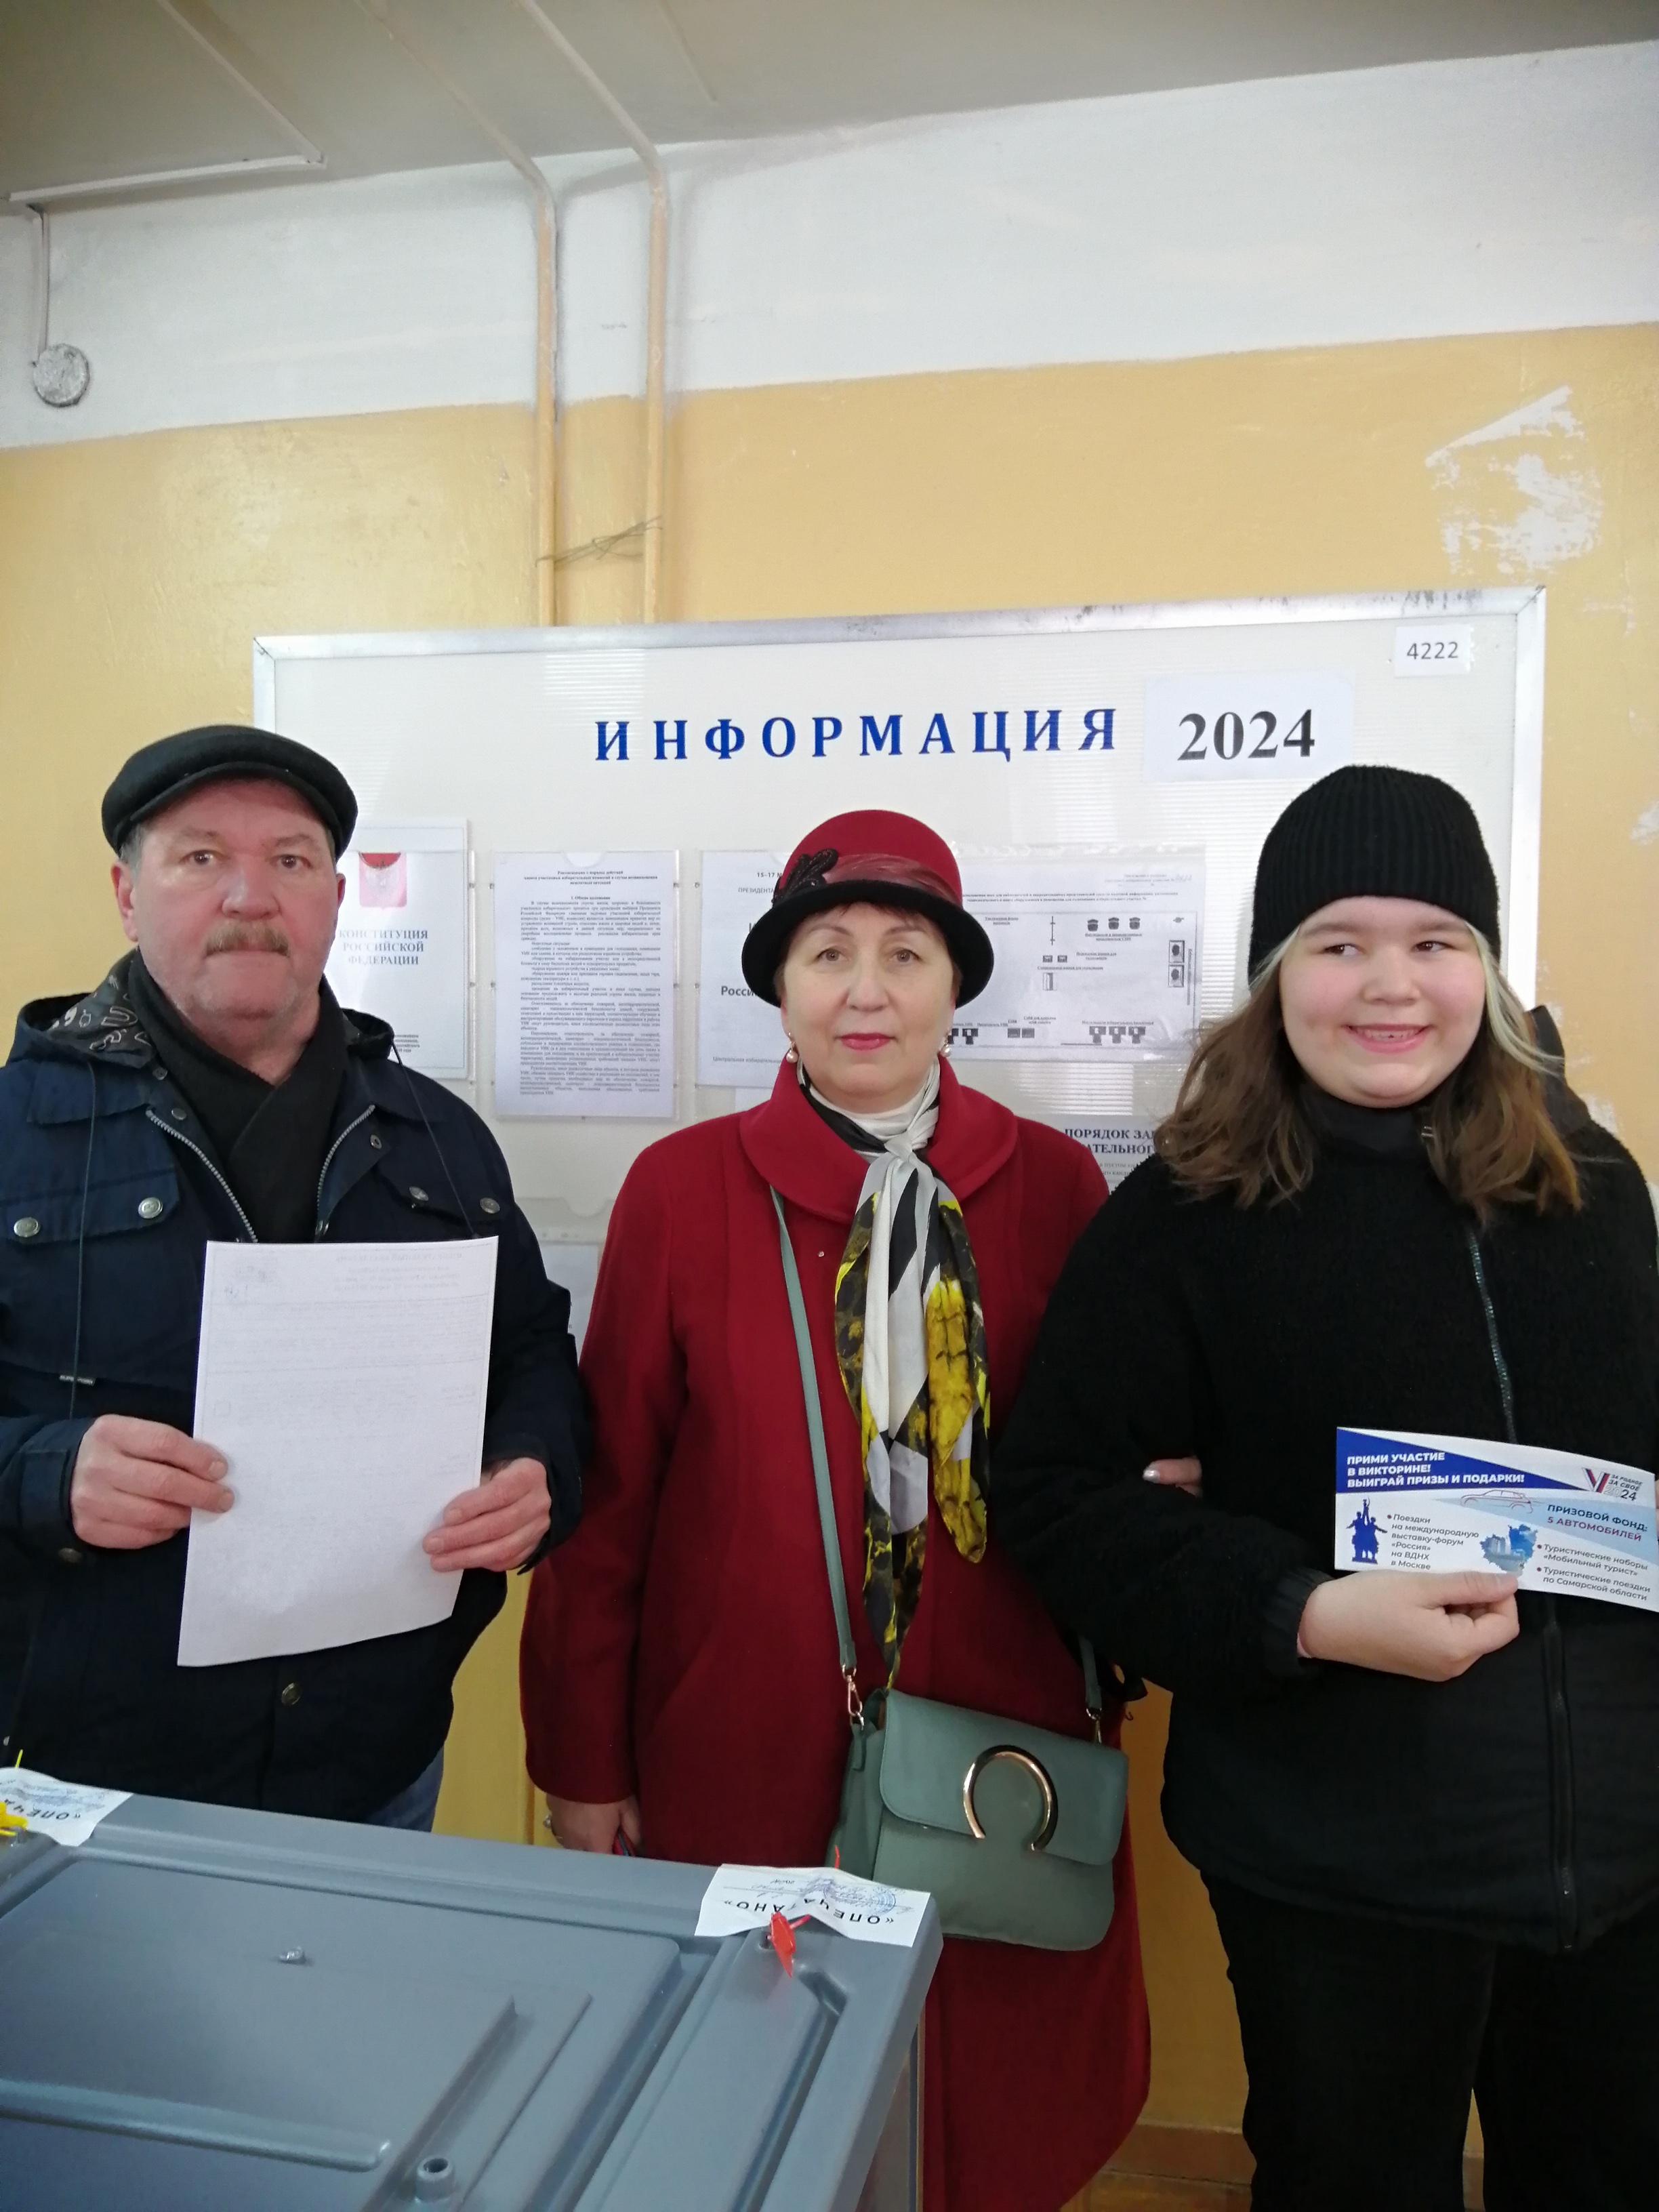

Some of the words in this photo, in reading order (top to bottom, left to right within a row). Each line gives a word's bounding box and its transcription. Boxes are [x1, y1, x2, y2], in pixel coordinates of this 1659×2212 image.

[1406, 641, 1458, 660] 4222
[594, 708, 1117, 762] ИНФОРМАЦИЯ
[1177, 708, 1315, 761] 2024
[339, 929, 428, 940] КОНСТИТУЦИЯ
[343, 941, 424, 952] РОССИЙСКОЙ
[348, 956, 419, 966] ФЕДЕРАЦИИ
[720, 985, 756, 996] Росси
[1134, 1130, 1155, 1139] ЗА
[1347, 1454, 1389, 1465] ПРИМИ
[1391, 1452, 1446, 1463] УЧАСТИЕ
[1347, 1467, 1356, 1477] В
[1358, 1464, 1431, 1477] ВИКТОРИНЕ!
[1347, 1475, 1404, 1488] ВЫИГРАЙ
[1406, 1475, 1448, 1486] ПРИЗЫ
[1451, 1475, 1460, 1483] И
[1462, 1474, 1525, 1484] ПОДАРКИ!
[1393, 1513, 1431, 1524] Поездки
[1547, 1504, 1610, 1521] ПРИЗОВОЙ
[1612, 1517, 1648, 1532] ФОНД:
[1405, 1525, 1479, 1539] международную
[1556, 1517, 1643, 1542] АВТОМОБИЛЕЙ
[1391, 1532, 1464, 1547] выставку-форум
[1391, 1541, 1431, 1551] «Россия»
[1404, 1551, 1430, 1560] ВДНХ
[1544, 1543, 1612, 1561] Туристические
[1613, 1557, 1648, 1571] наборы
[1398, 1560, 1431, 1570] Москве
[1543, 1553, 1601, 1569] «Мобильный
[1603, 1564, 1638, 1577] турист»
[1544, 1566, 1612, 1584] Туристические
[1613, 1580, 1651, 1593] поездки
[1556, 1578, 1608, 1593] Самарской
[1610, 1588, 1647, 1601] области
